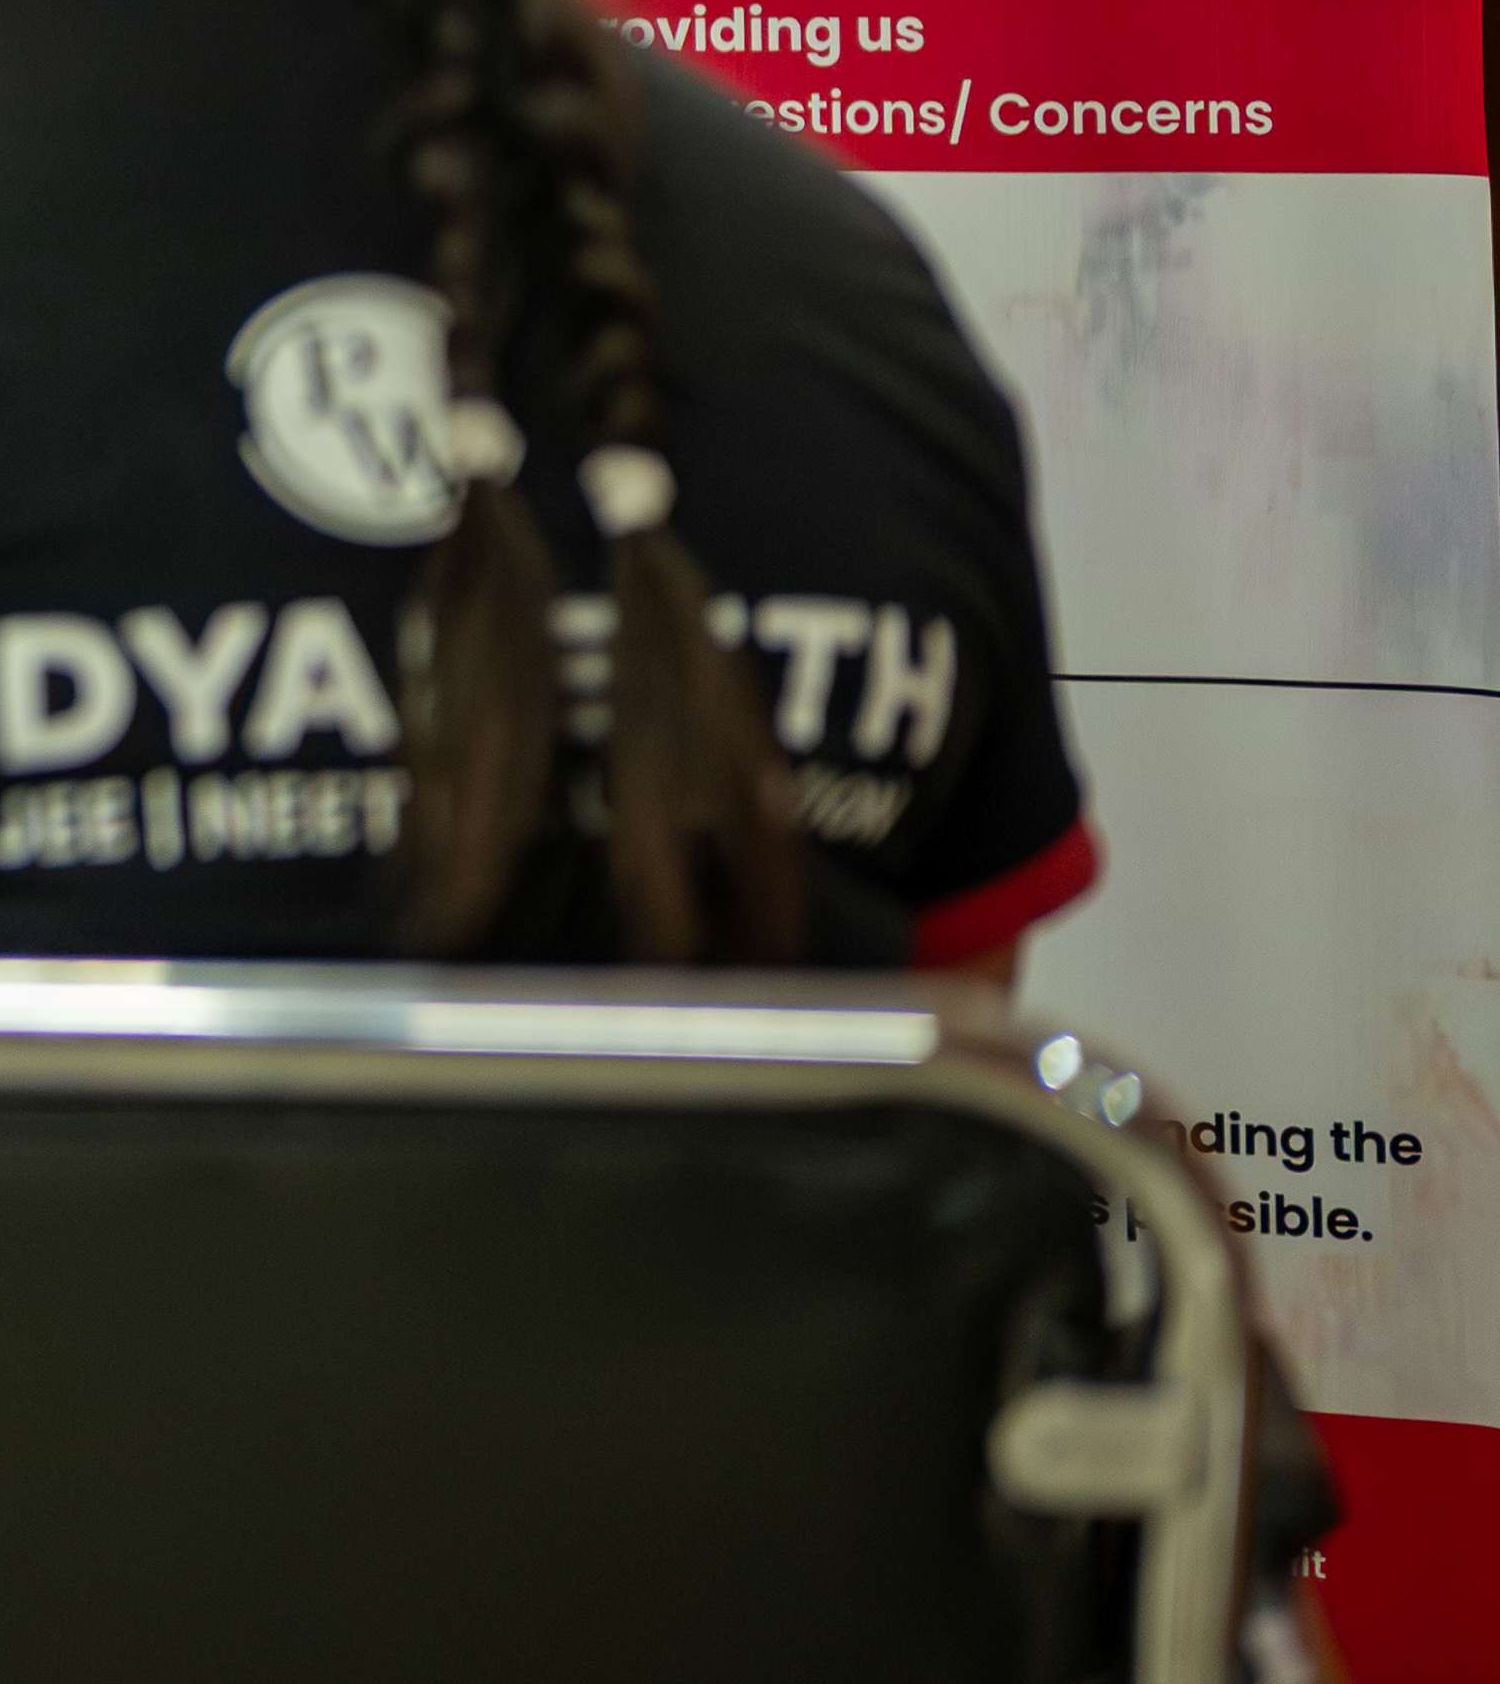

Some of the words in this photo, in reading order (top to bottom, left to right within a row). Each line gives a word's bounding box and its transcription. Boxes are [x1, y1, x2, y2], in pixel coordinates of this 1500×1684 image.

[604, 4, 841, 68] oviding
[857, 16, 925, 53] us
[732, 79, 972, 146] estions/
[989, 91, 1274, 138] Concerns
[1330, 1121, 1423, 1166] the
[1126, 1191, 1373, 1243] sible.
